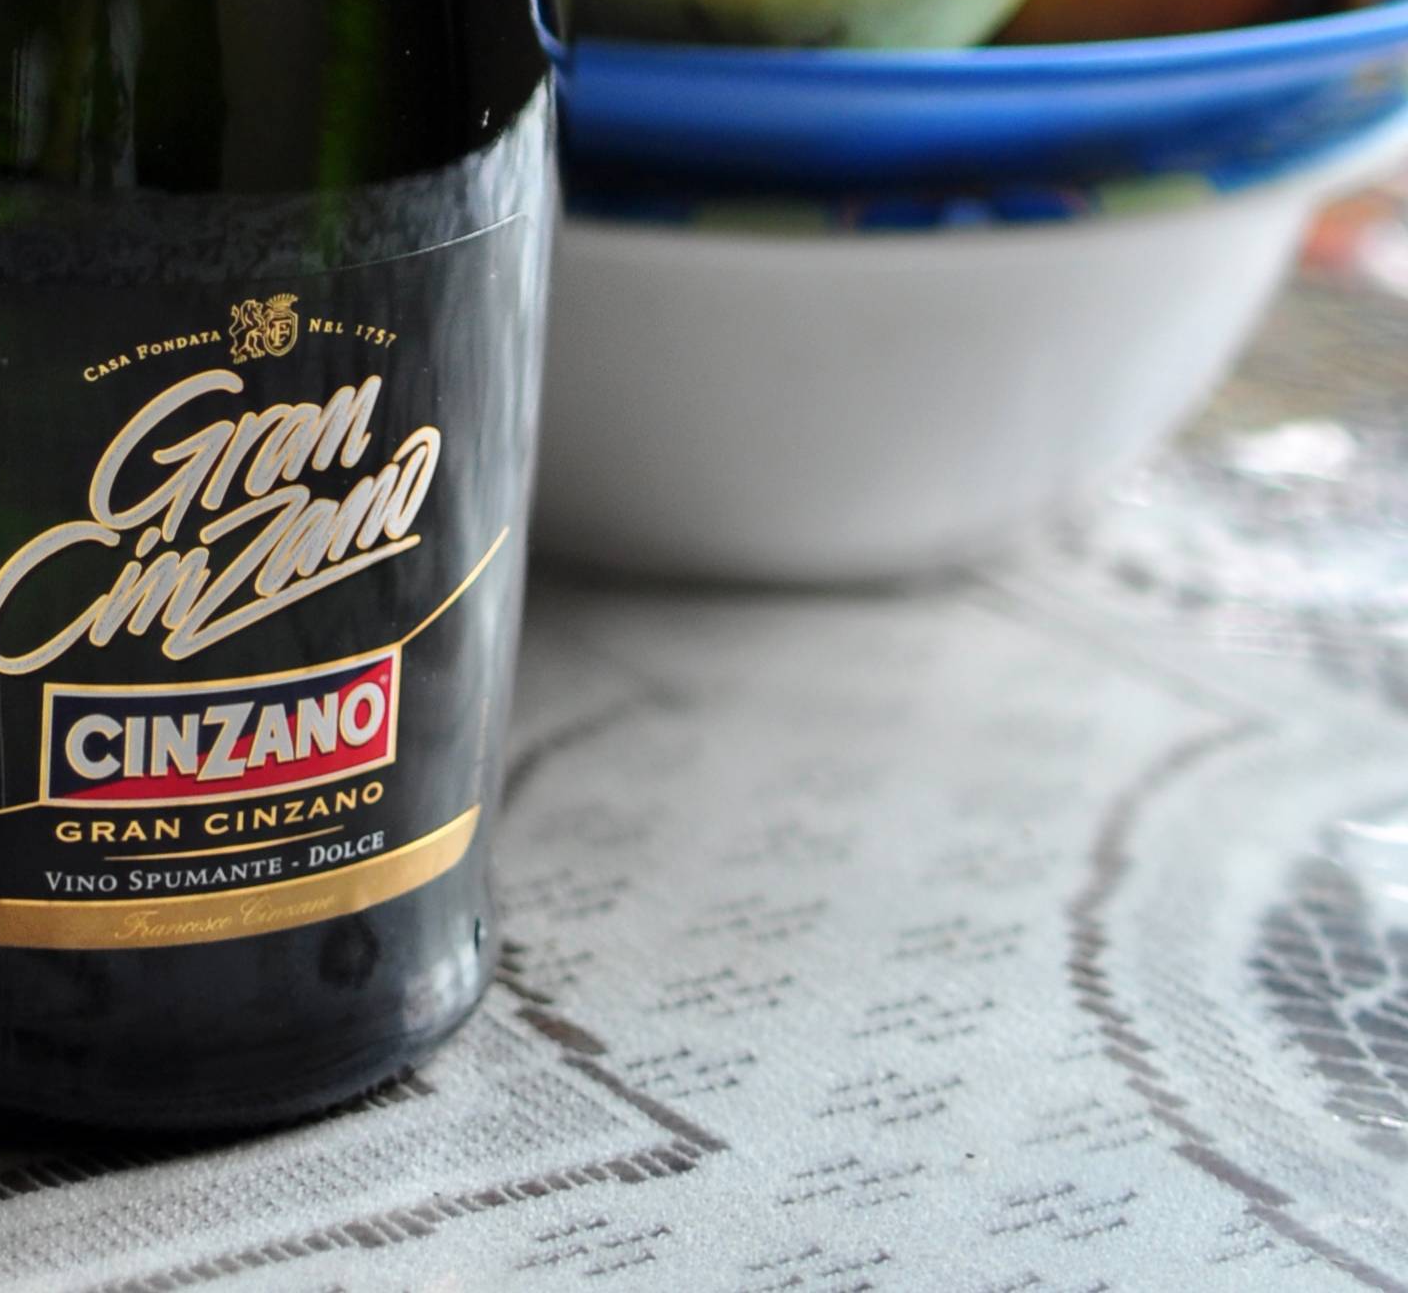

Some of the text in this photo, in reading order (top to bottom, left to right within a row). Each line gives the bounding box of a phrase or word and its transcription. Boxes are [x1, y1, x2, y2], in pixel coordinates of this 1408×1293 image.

[83, 329, 222, 382] CASA FONDATA
[355, 325, 397, 348] 1757
[89, 368, 383, 543] Gran
[64, 681, 386, 782] CINZANO
[55, 781, 384, 843] GRAN CINZANO
[45, 871, 118, 892] VINO
[129, 857, 283, 891] SPUMANTE
[309, 830, 385, 868] DOLCE
